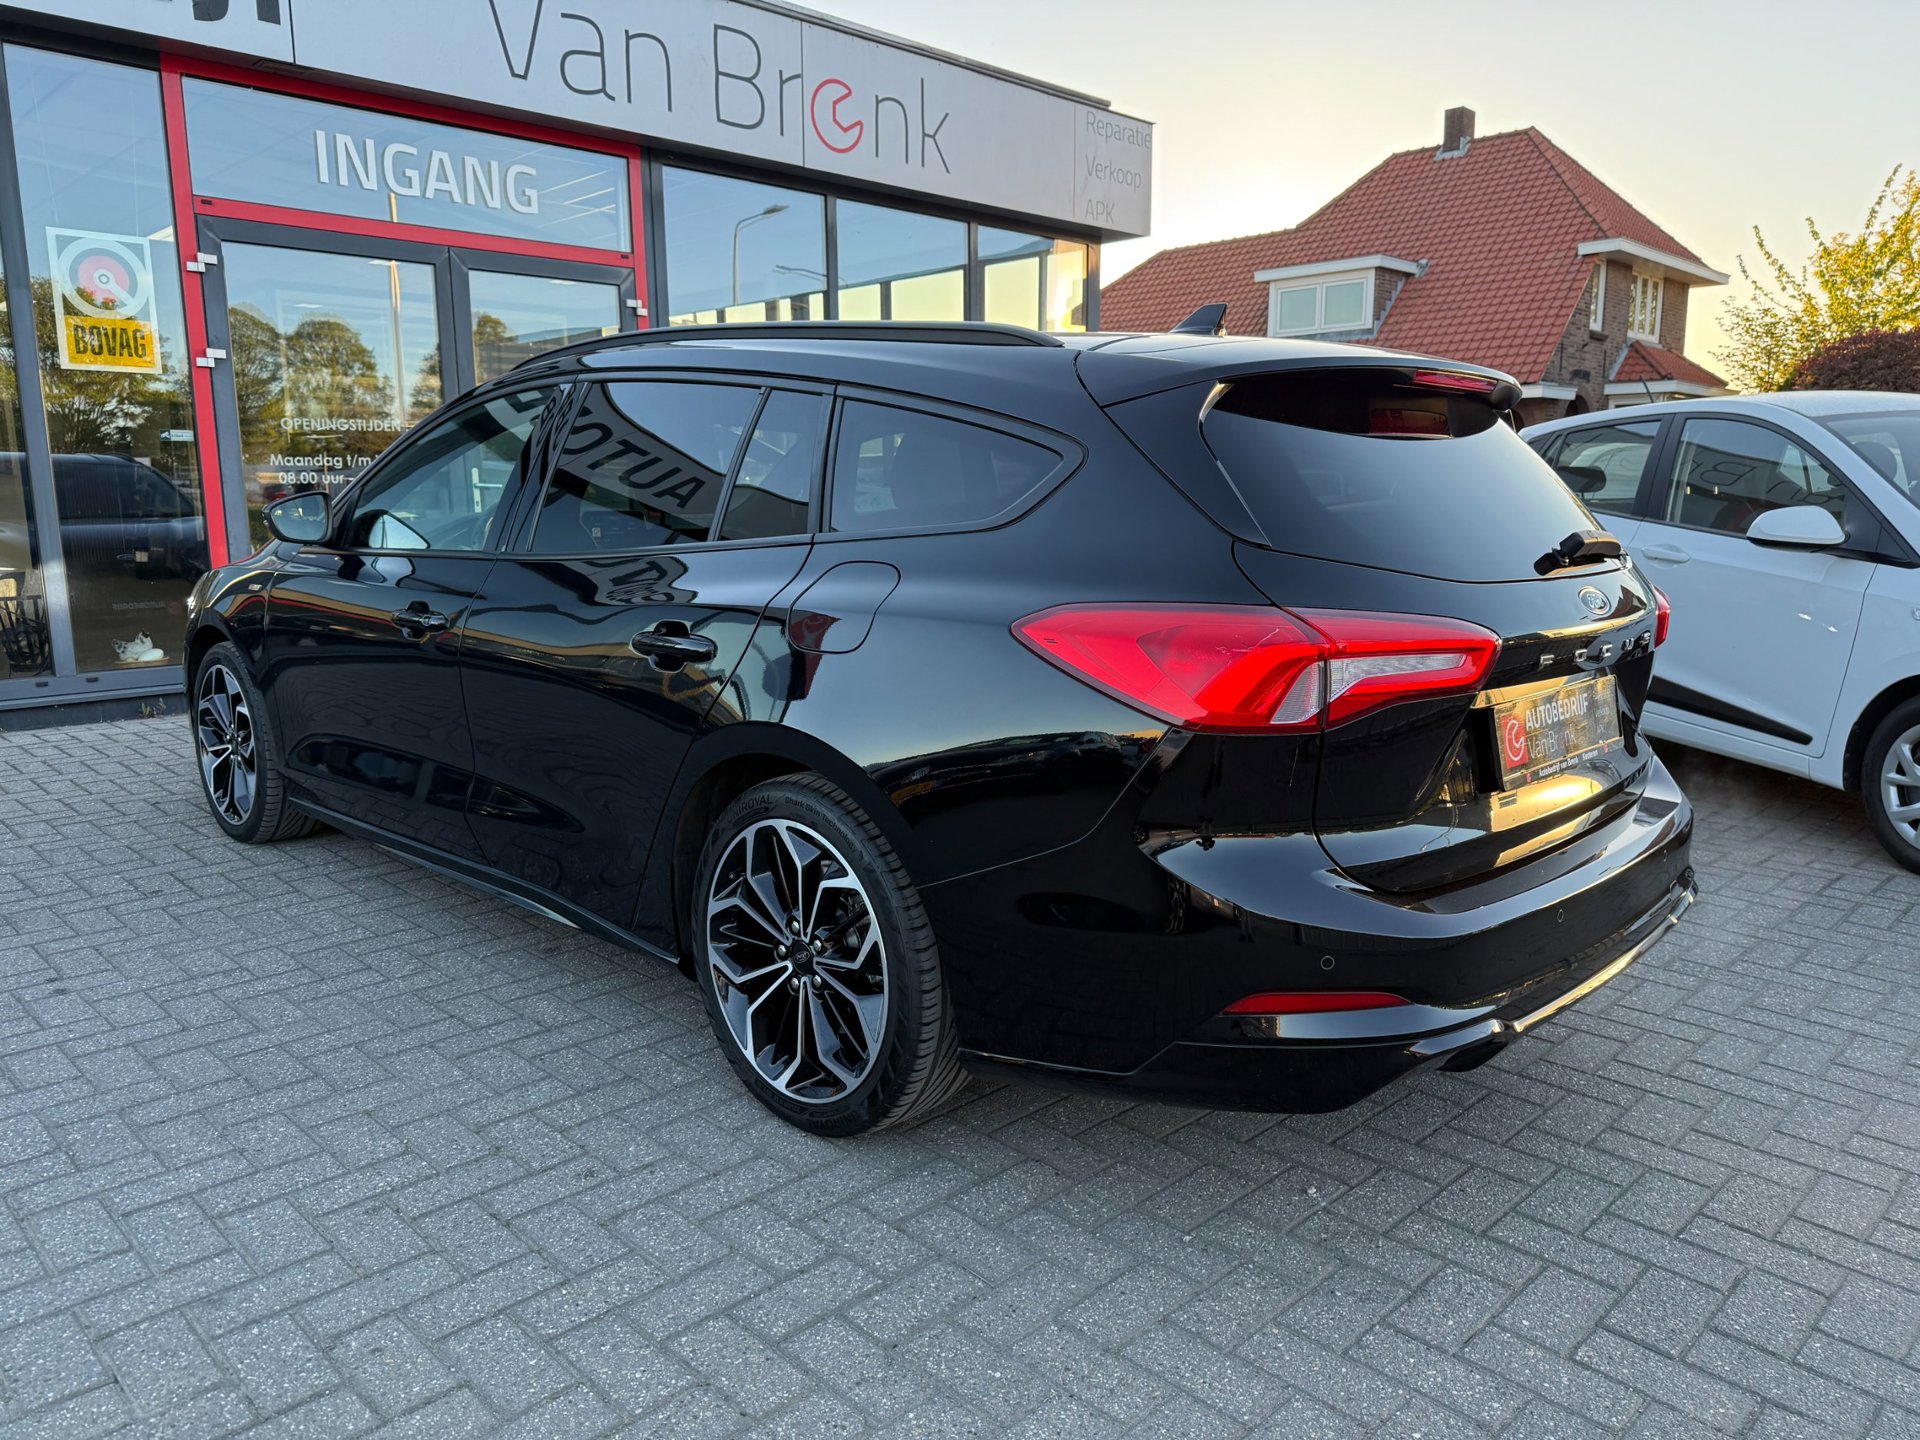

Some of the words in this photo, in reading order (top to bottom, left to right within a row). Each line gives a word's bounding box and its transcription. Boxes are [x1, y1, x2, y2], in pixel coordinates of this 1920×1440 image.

[488, 0, 672, 112] Van
[1086, 110, 1152, 149] Reparatie
[314, 129, 540, 214] INGANG
[1085, 153, 1142, 192] Verkoop
[1084, 199, 1116, 225] APK
[73, 322, 147, 359] BOVAG
[269, 453, 343, 468] Maandag
[278, 471, 318, 484] 08.00
[321, 473, 345, 484] uur
[1539, 632, 1651, 671] FOCUS
[1525, 692, 1589, 731] AUTOBEDRIJF
